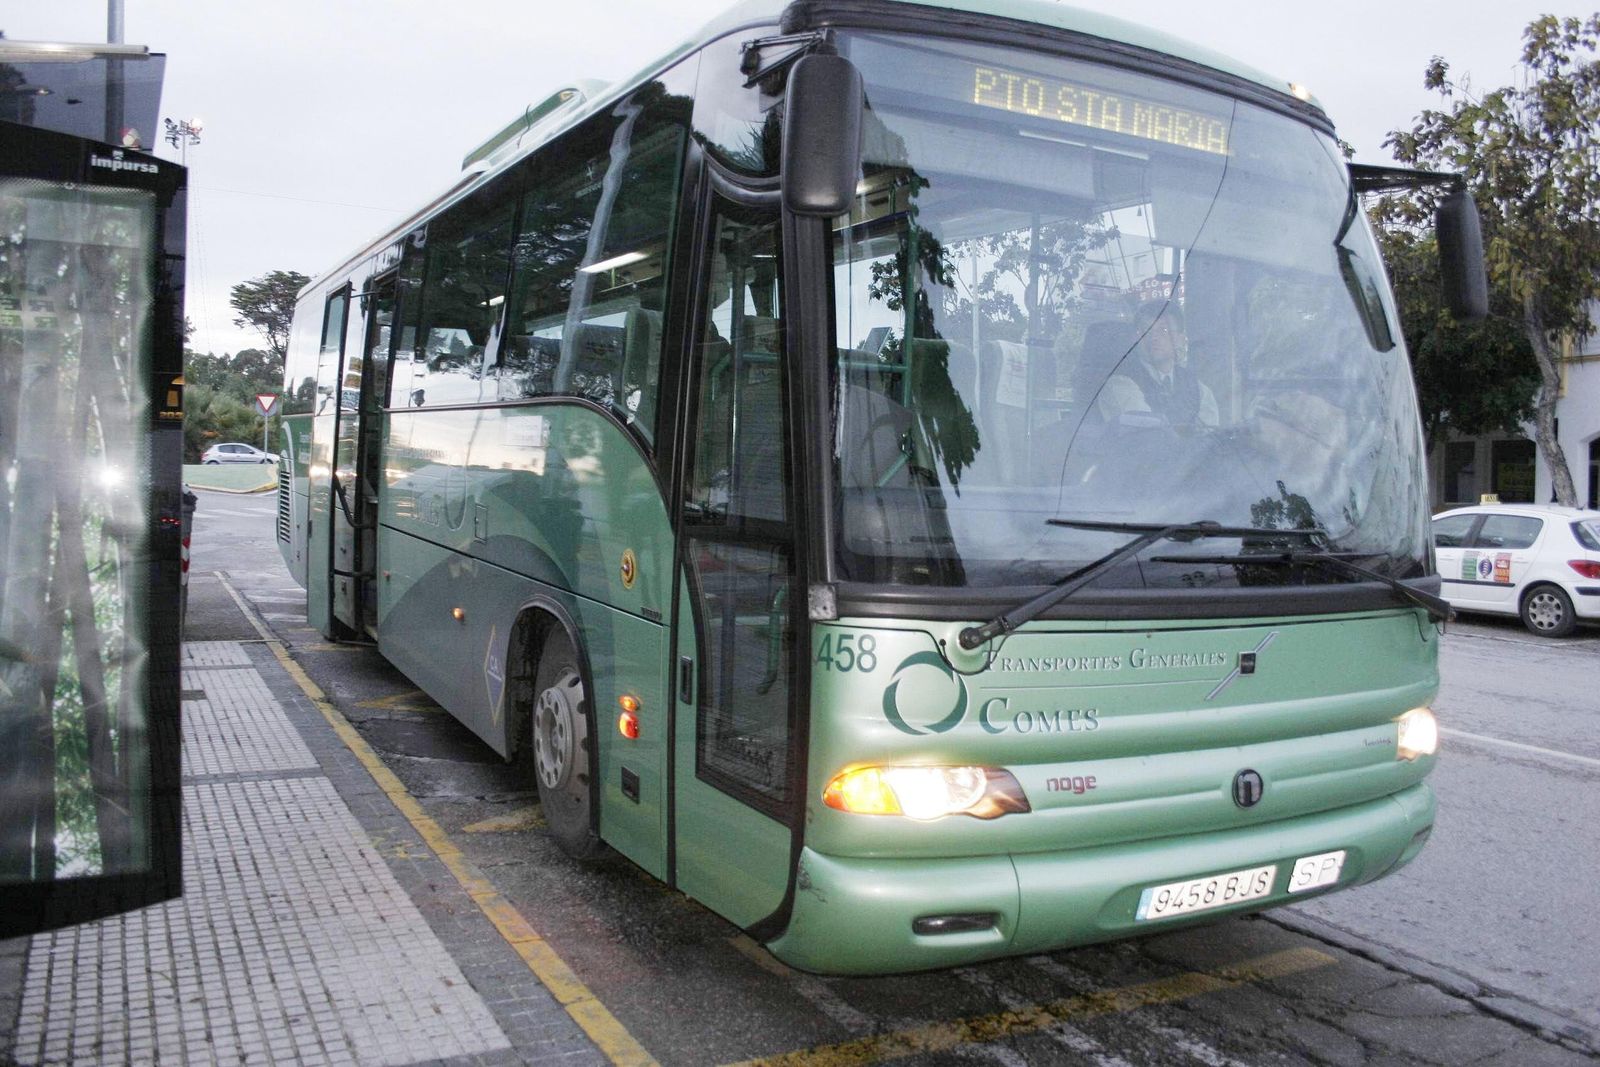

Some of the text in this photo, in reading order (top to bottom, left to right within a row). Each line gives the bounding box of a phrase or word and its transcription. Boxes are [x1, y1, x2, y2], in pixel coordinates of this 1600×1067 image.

[974, 67, 1226, 154] PTO STA MARIA
[91, 154, 159, 174] impursa
[817, 633, 877, 673] 458
[1129, 648, 1226, 670] GENERALES
[979, 697, 1099, 735] COMES
[1047, 776, 1096, 795] noge
[1297, 858, 1336, 887] SP
[1155, 881, 1218, 913] 9458
[1224, 871, 1269, 901] BJS
